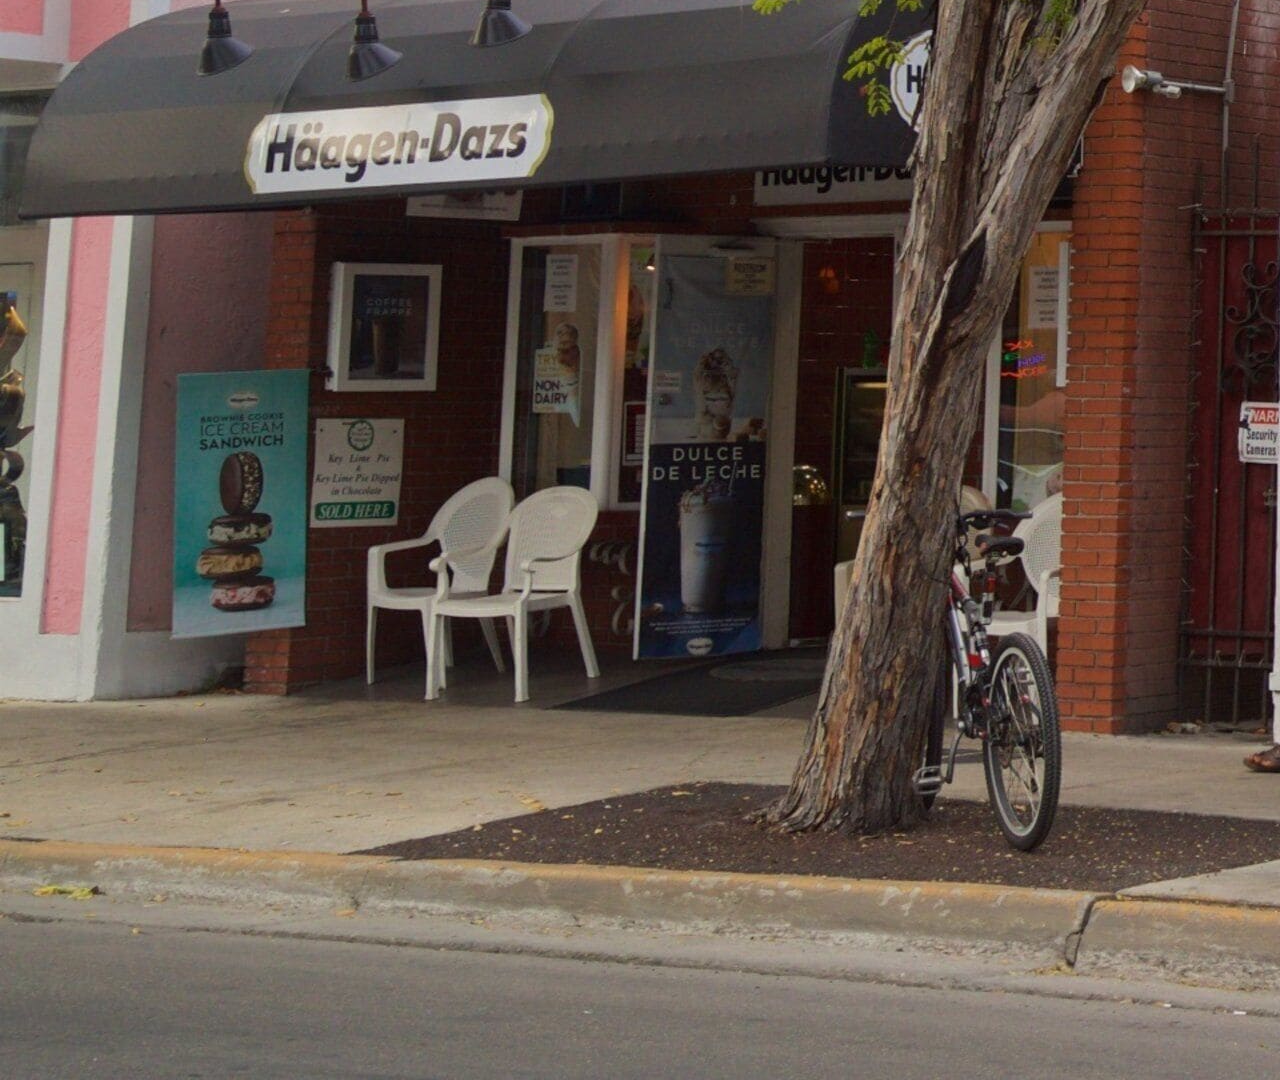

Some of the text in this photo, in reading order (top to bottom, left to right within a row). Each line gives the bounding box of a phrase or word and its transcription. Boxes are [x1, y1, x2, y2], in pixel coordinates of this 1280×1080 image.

[265, 113, 527, 182] Häagen-Dazs
[536, 380, 564, 391] NON-
[535, 392, 567, 404] DAIRY
[200, 411, 284, 422] BROWNIE COOKIE
[200, 421, 284, 436] ICE CREAM
[1246, 429, 1278, 443] Security
[200, 434, 284, 451] SANDWICH
[1246, 443, 1277, 456] Cameras
[673, 446, 745, 463] DULCE
[653, 464, 761, 481] DE LECHE
[318, 503, 391, 519] SOLD HERE
